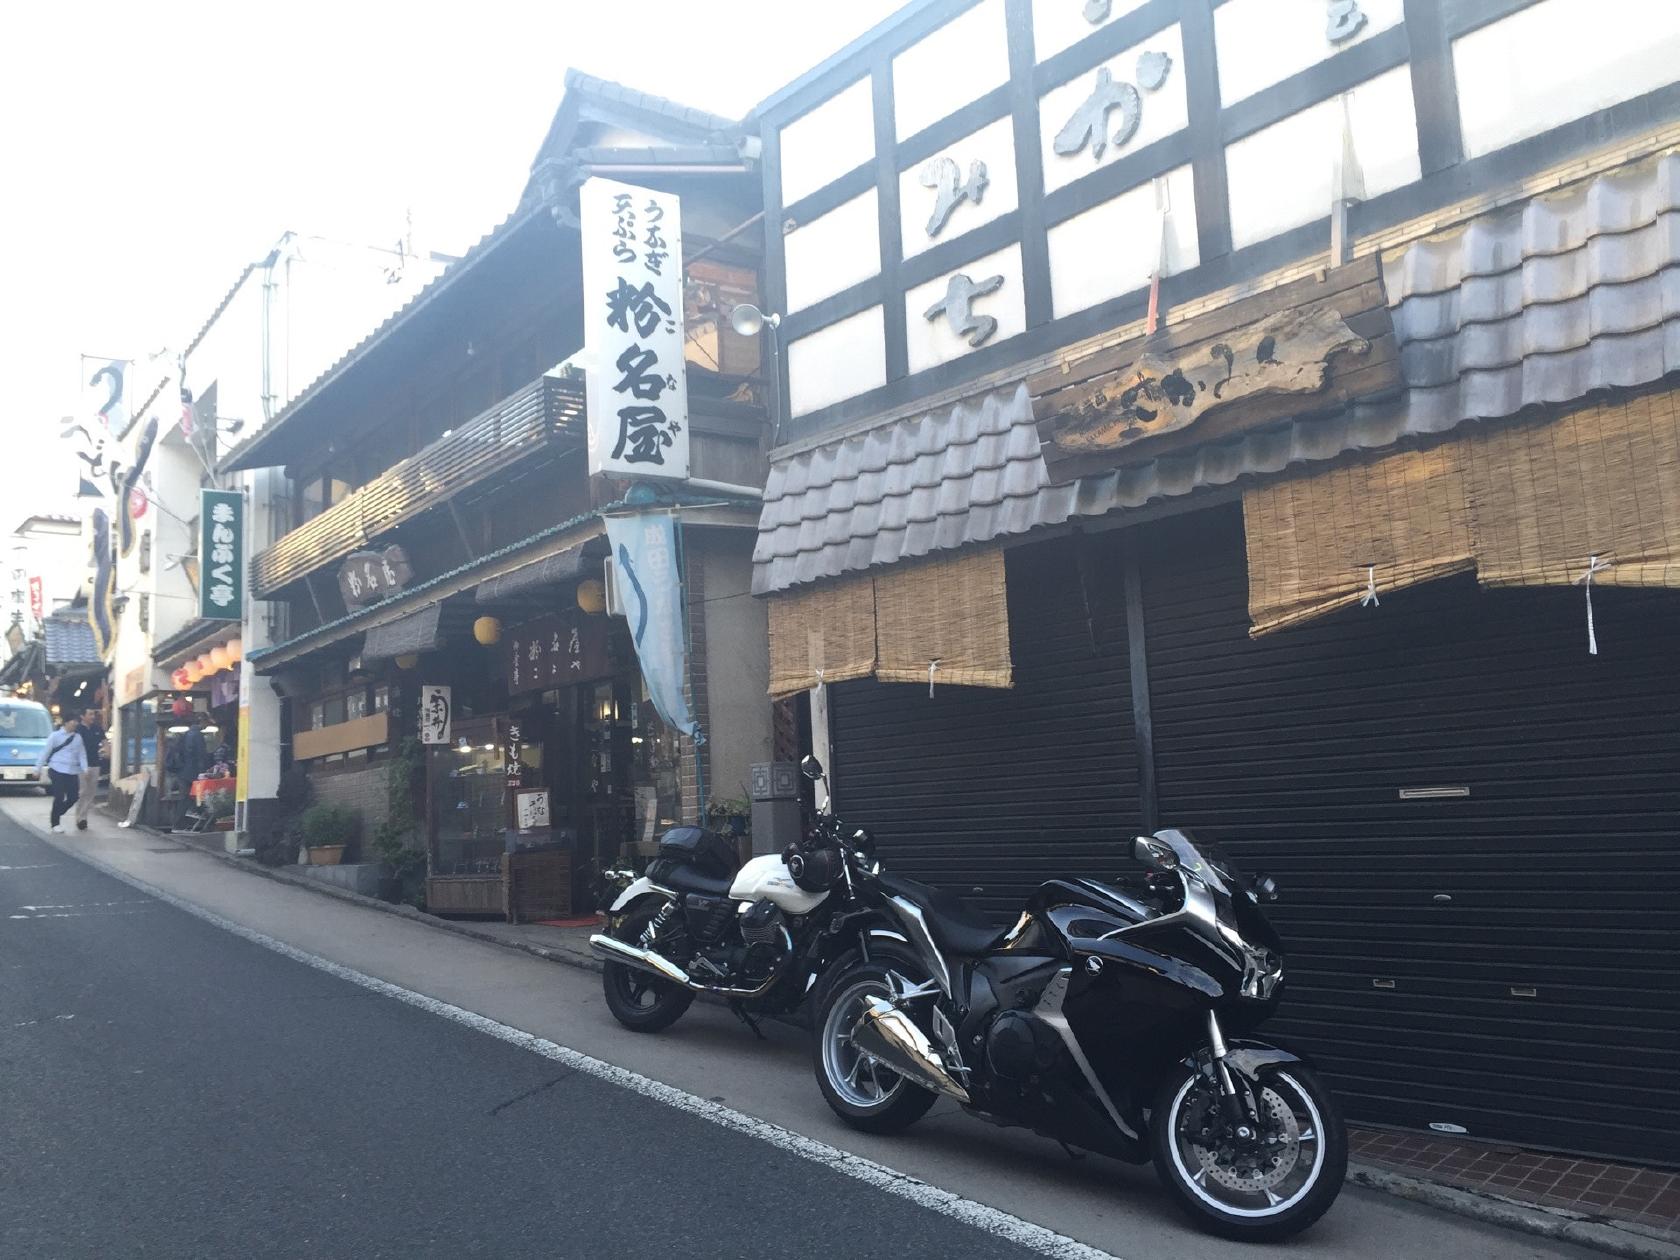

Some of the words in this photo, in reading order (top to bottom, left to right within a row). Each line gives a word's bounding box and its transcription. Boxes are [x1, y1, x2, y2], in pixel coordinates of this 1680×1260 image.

[606, 276, 673, 466] 粉名屋
[507, 725, 522, 776] きも焼
